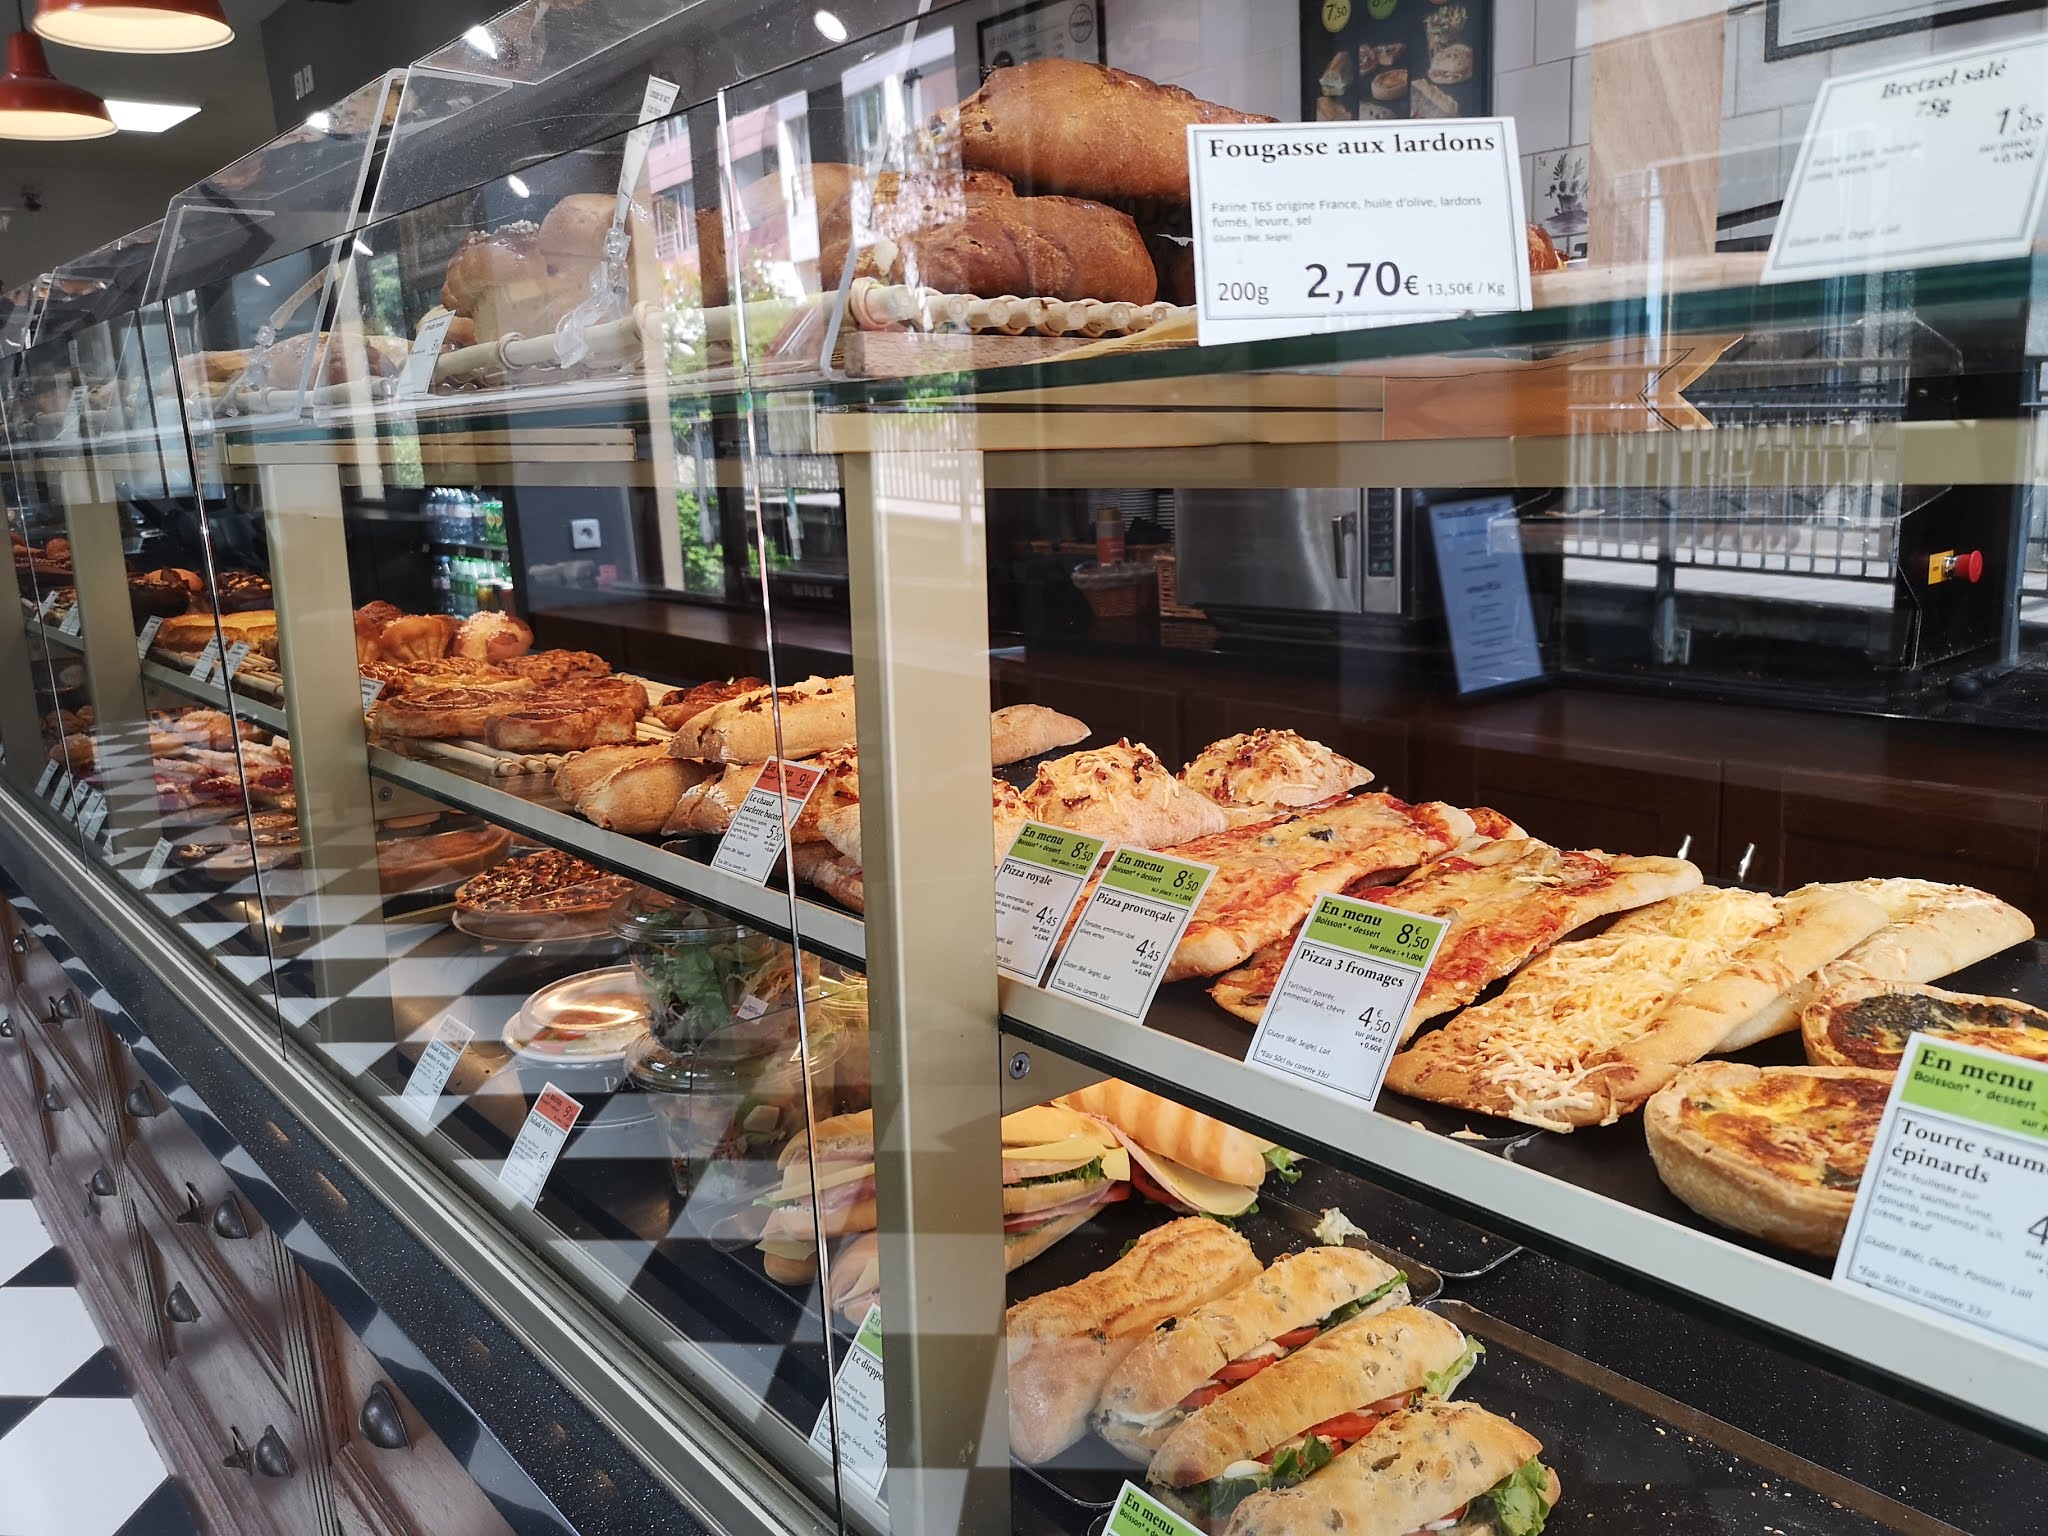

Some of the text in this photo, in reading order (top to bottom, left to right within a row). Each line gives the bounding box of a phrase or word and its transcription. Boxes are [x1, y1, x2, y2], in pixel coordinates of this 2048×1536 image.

[1881, 57, 2008, 99] Bretzel salé
[1209, 133, 1496, 163] Fougasse aux lardons
[1211, 196, 1482, 213] Farine T65 origine France, huile d'olive, lardons
[1212, 215, 1312, 228] fumés, levure, sel
[1218, 281, 1269, 306] 200g
[1305, 261, 1419, 304] 2,70€
[1427, 282, 1474, 296] 13,50€
[1487, 282, 1505, 296] Kg
[749, 794, 775, 807] Le chaud
[743, 805, 782, 821] raclette bacon
[1022, 826, 1036, 838] En
[1037, 832, 1064, 845] menu
[1042, 845, 1061, 855] dessert
[1117, 852, 1132, 865] En
[1133, 859, 1164, 873] menu
[1002, 863, 1053, 886] Pizza royale
[1140, 872, 1162, 883] dessert
[1096, 892, 1176, 923] Pizza provençale
[1320, 900, 1339, 916] En
[1342, 908, 1382, 927] menu
[1353, 925, 1381, 939] dessert
[1369, 942, 1379, 950] sur
[1406, 953, 1424, 962] 1,00€
[1300, 948, 1405, 988] Pizza 3 fromages
[1287, 980, 1336, 1002] Tartinade poivrée,
[1282, 991, 1346, 1015] emmental râpé, chèvre
[1266, 1028, 1285, 1040] Gluten
[1318, 1045, 1331, 1056] Lait
[1364, 1041, 1382, 1053] 0,60€
[1273, 1054, 1286, 1064] 50cl
[1294, 1062, 1316, 1075] canette
[1316, 1070, 1330, 1079] 33cl
[1920, 1049, 2033, 1092] En menu
[1986, 1090, 2036, 1111] dessert
[541, 1123, 554, 1137] PAUL
[2021, 1118, 2039, 1129] sur
[1902, 1117, 2048, 1175] Tourte saum
[1892, 1141, 1989, 1183] épinards
[2024, 1249, 2043, 1261] sur
[1863, 1234, 1897, 1253] Gluten
[2010, 1286, 2033, 1300] Lait
[869, 1313, 881, 1327] En
[851, 1351, 884, 1382] Le dieppo
[1124, 1492, 1175, 1536] En menu
